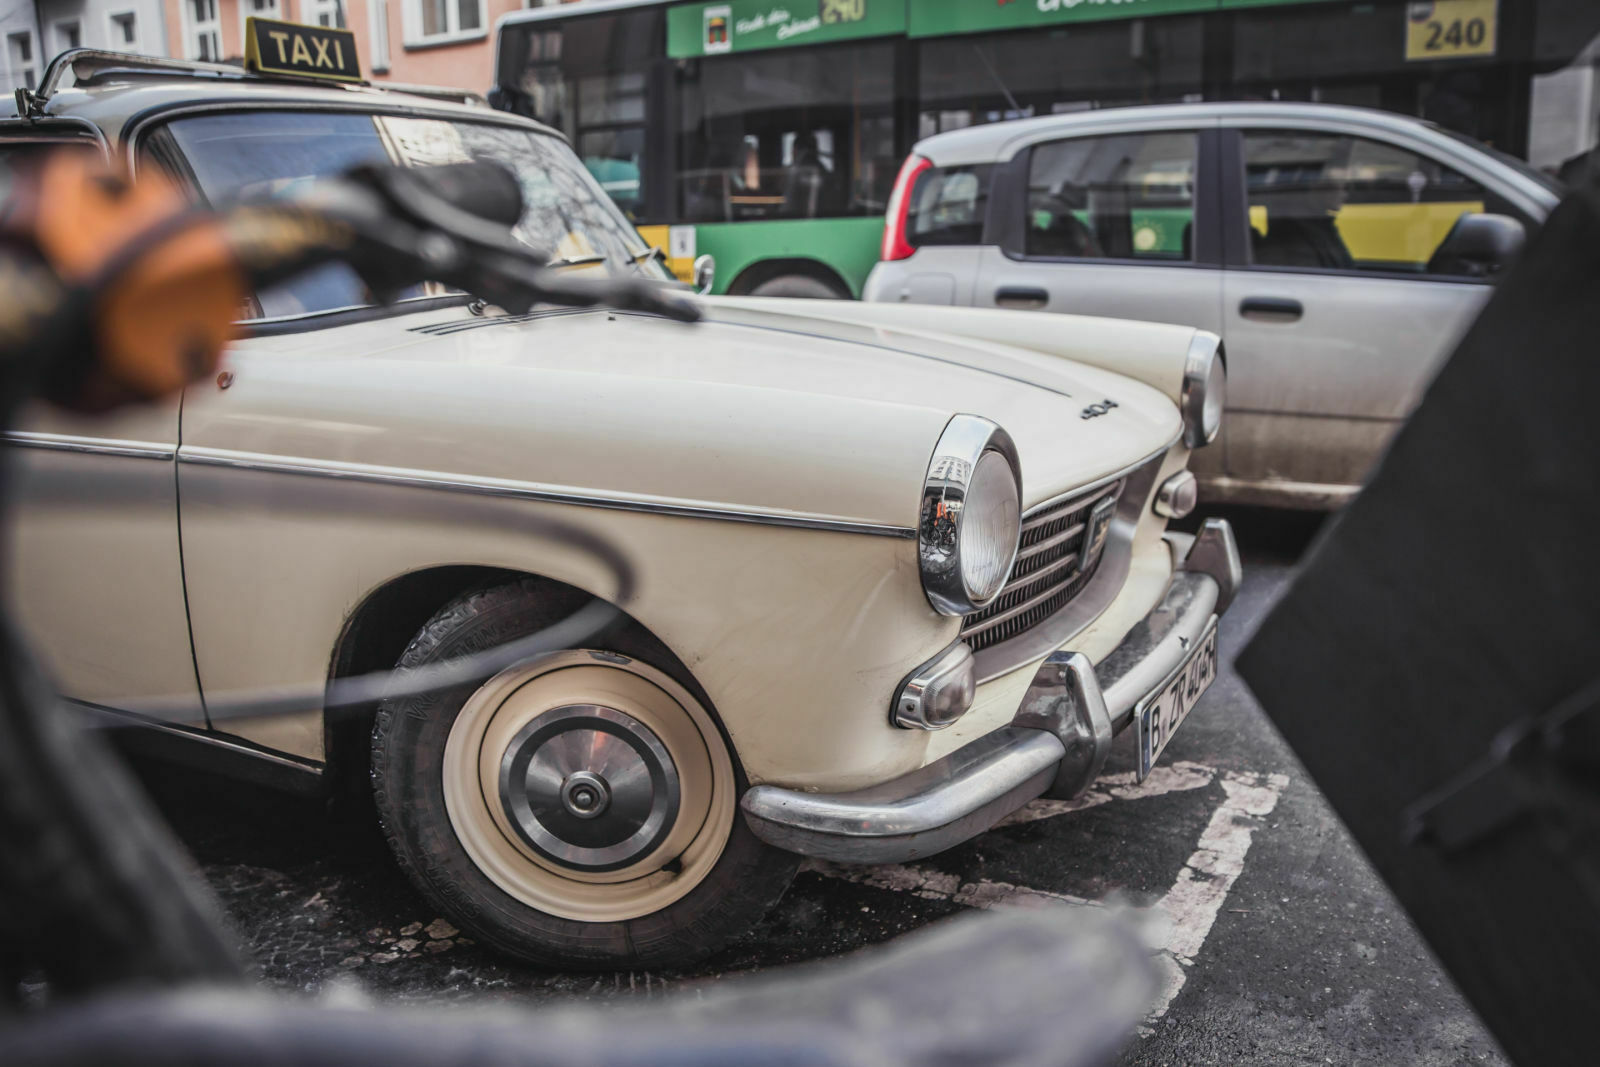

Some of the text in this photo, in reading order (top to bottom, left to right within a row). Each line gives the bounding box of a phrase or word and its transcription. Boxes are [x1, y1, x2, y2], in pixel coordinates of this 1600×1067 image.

[822, 0, 865, 24] 240
[268, 30, 345, 70] TAXI
[1424, 17, 1486, 51] 240
[1151, 705, 1161, 757] B
